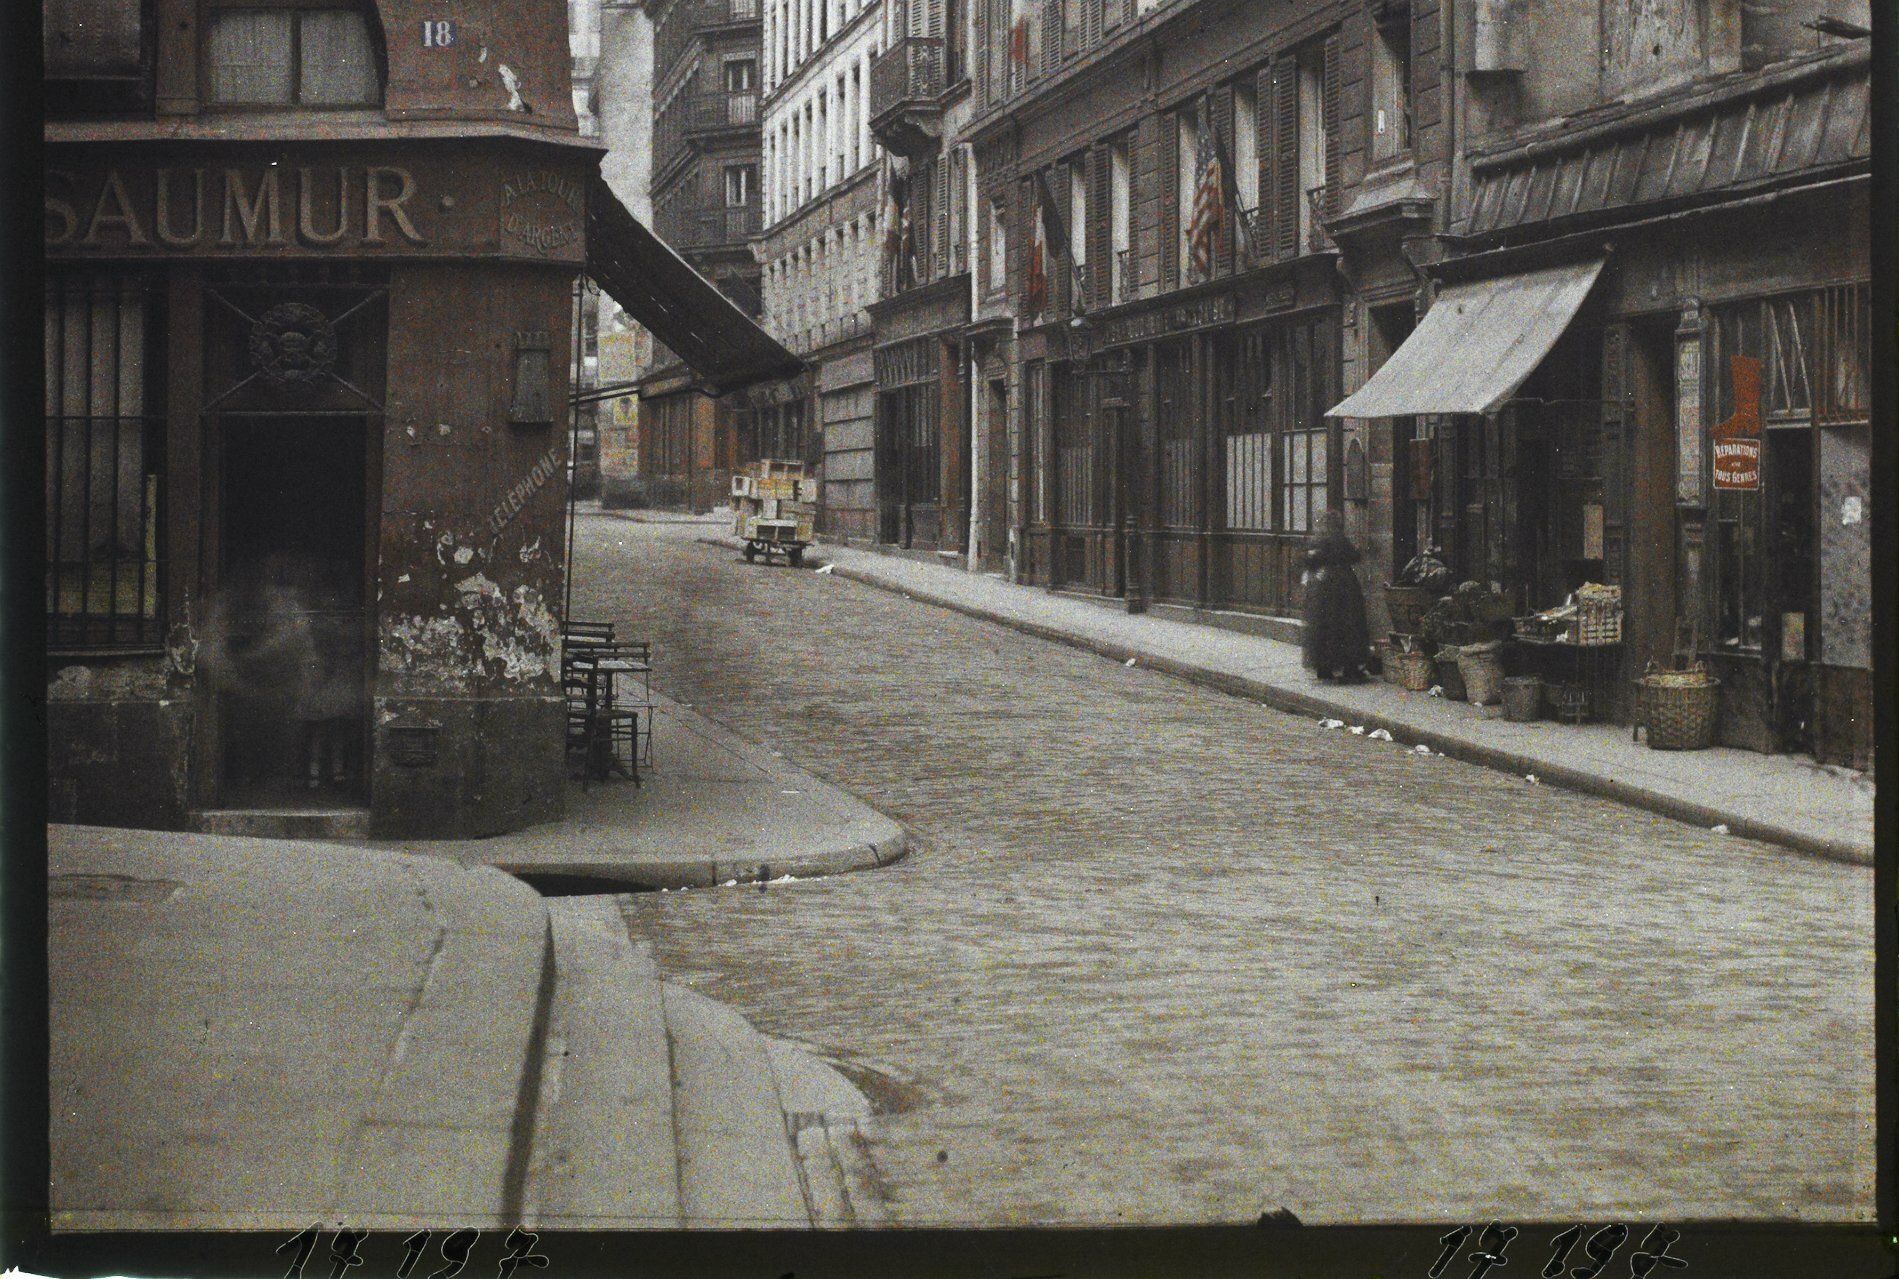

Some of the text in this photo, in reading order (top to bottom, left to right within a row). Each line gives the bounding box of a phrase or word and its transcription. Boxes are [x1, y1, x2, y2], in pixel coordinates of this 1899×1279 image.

[423, 20, 451, 47] 18
[45, 166, 426, 247] SAUMUR
[1715, 469, 1758, 483] TOUS GENRES
